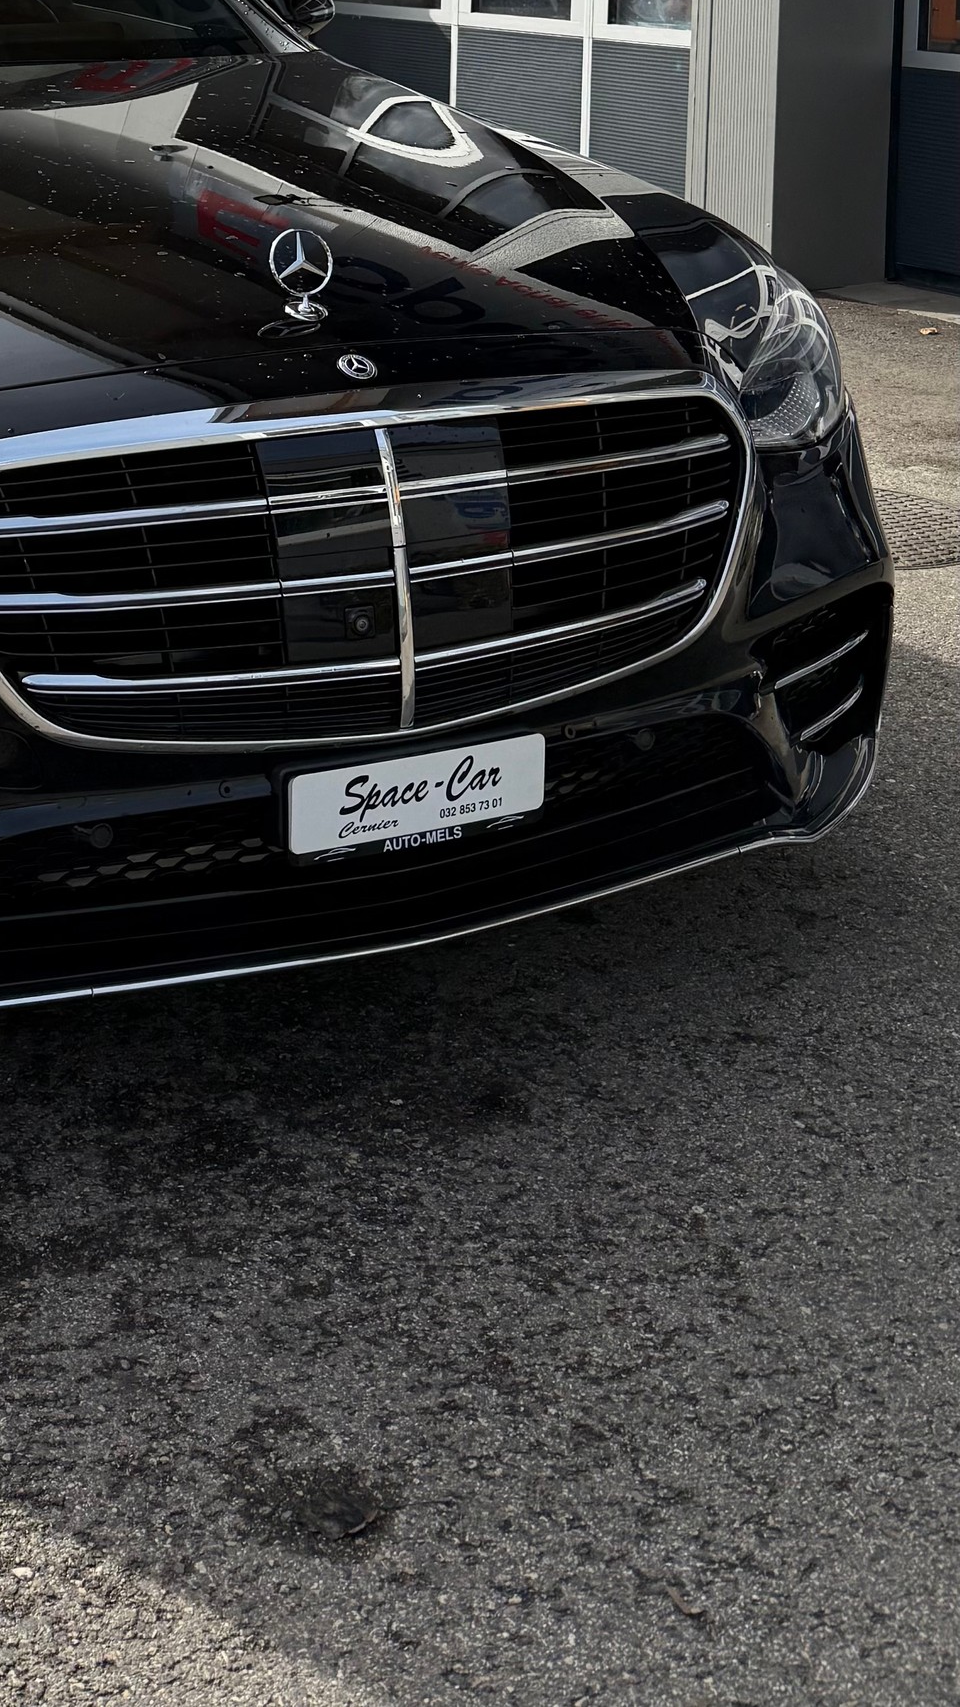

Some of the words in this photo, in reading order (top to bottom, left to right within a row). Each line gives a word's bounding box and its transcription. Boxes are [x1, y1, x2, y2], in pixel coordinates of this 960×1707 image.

[439, 806, 457, 819] 032
[459, 802, 476, 815] 853
[479, 799, 490, 811] 73
[492, 797, 503, 809] 01
[338, 819, 400, 839] Cernier
[383, 826, 463, 853] AUTO-MELS
